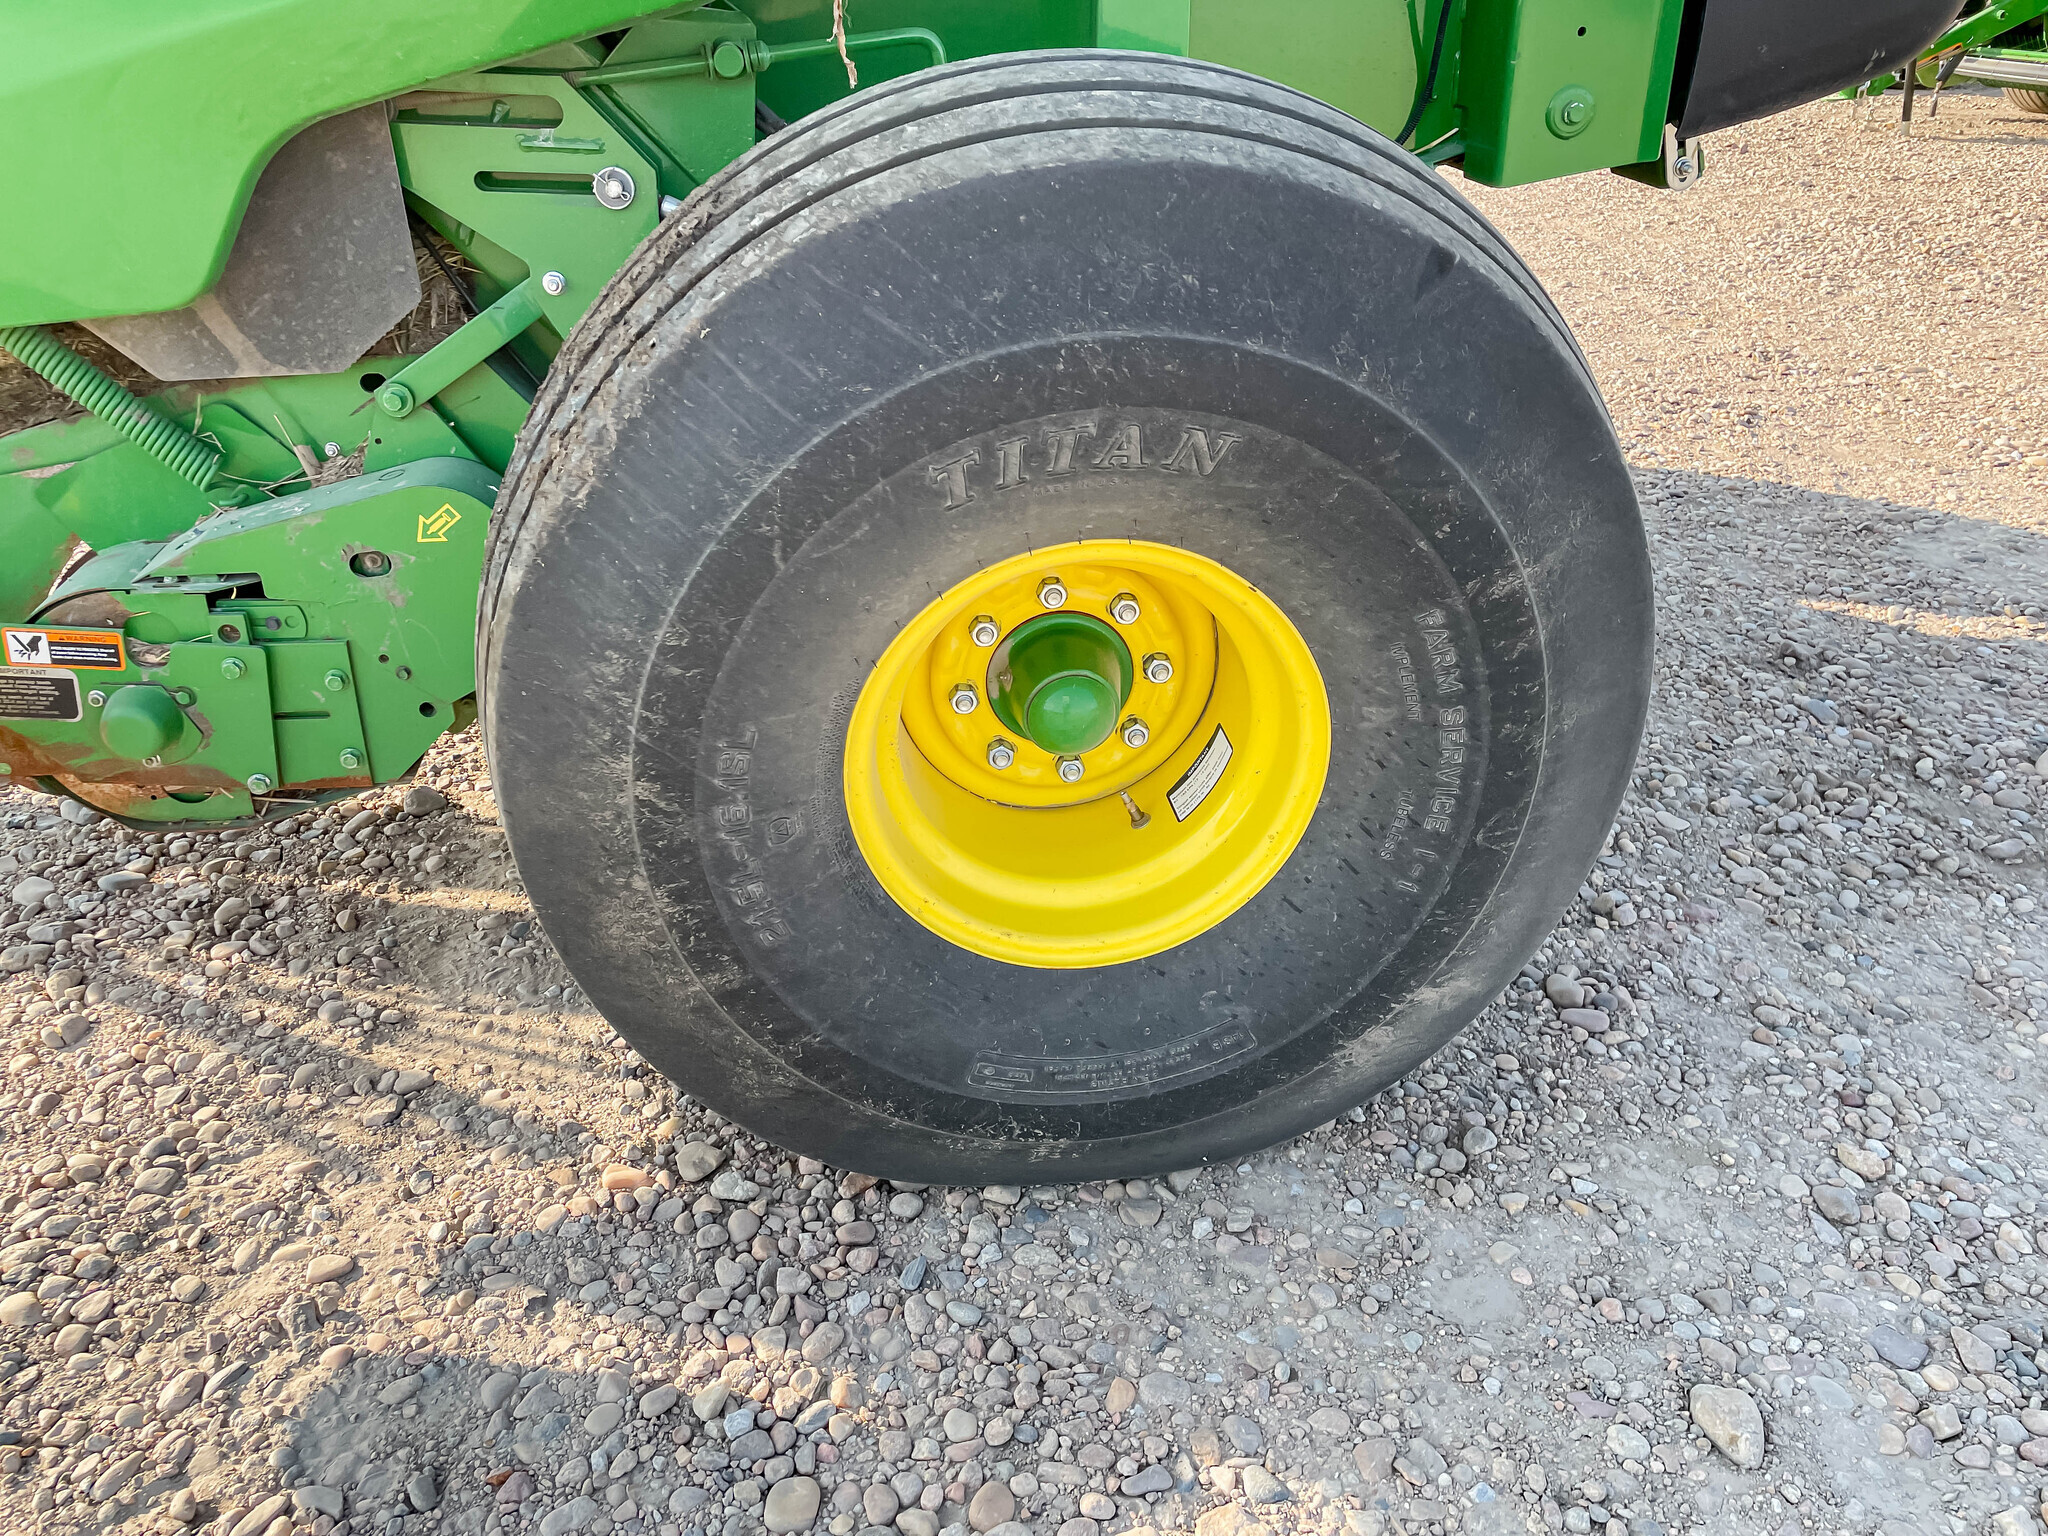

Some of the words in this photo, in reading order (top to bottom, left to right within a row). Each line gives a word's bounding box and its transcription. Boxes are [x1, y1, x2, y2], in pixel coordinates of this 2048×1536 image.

[928, 422, 1243, 513] TITAN
[0, 667, 47, 676] MPORTANT
[65, 635, 107, 645] WARNING
[1414, 606, 1464, 695] FARM
[1389, 641, 1422, 722] IMPLEMENT
[1423, 705, 1468, 834] SERVICE
[1378, 789, 1415, 860] TUBELESS
